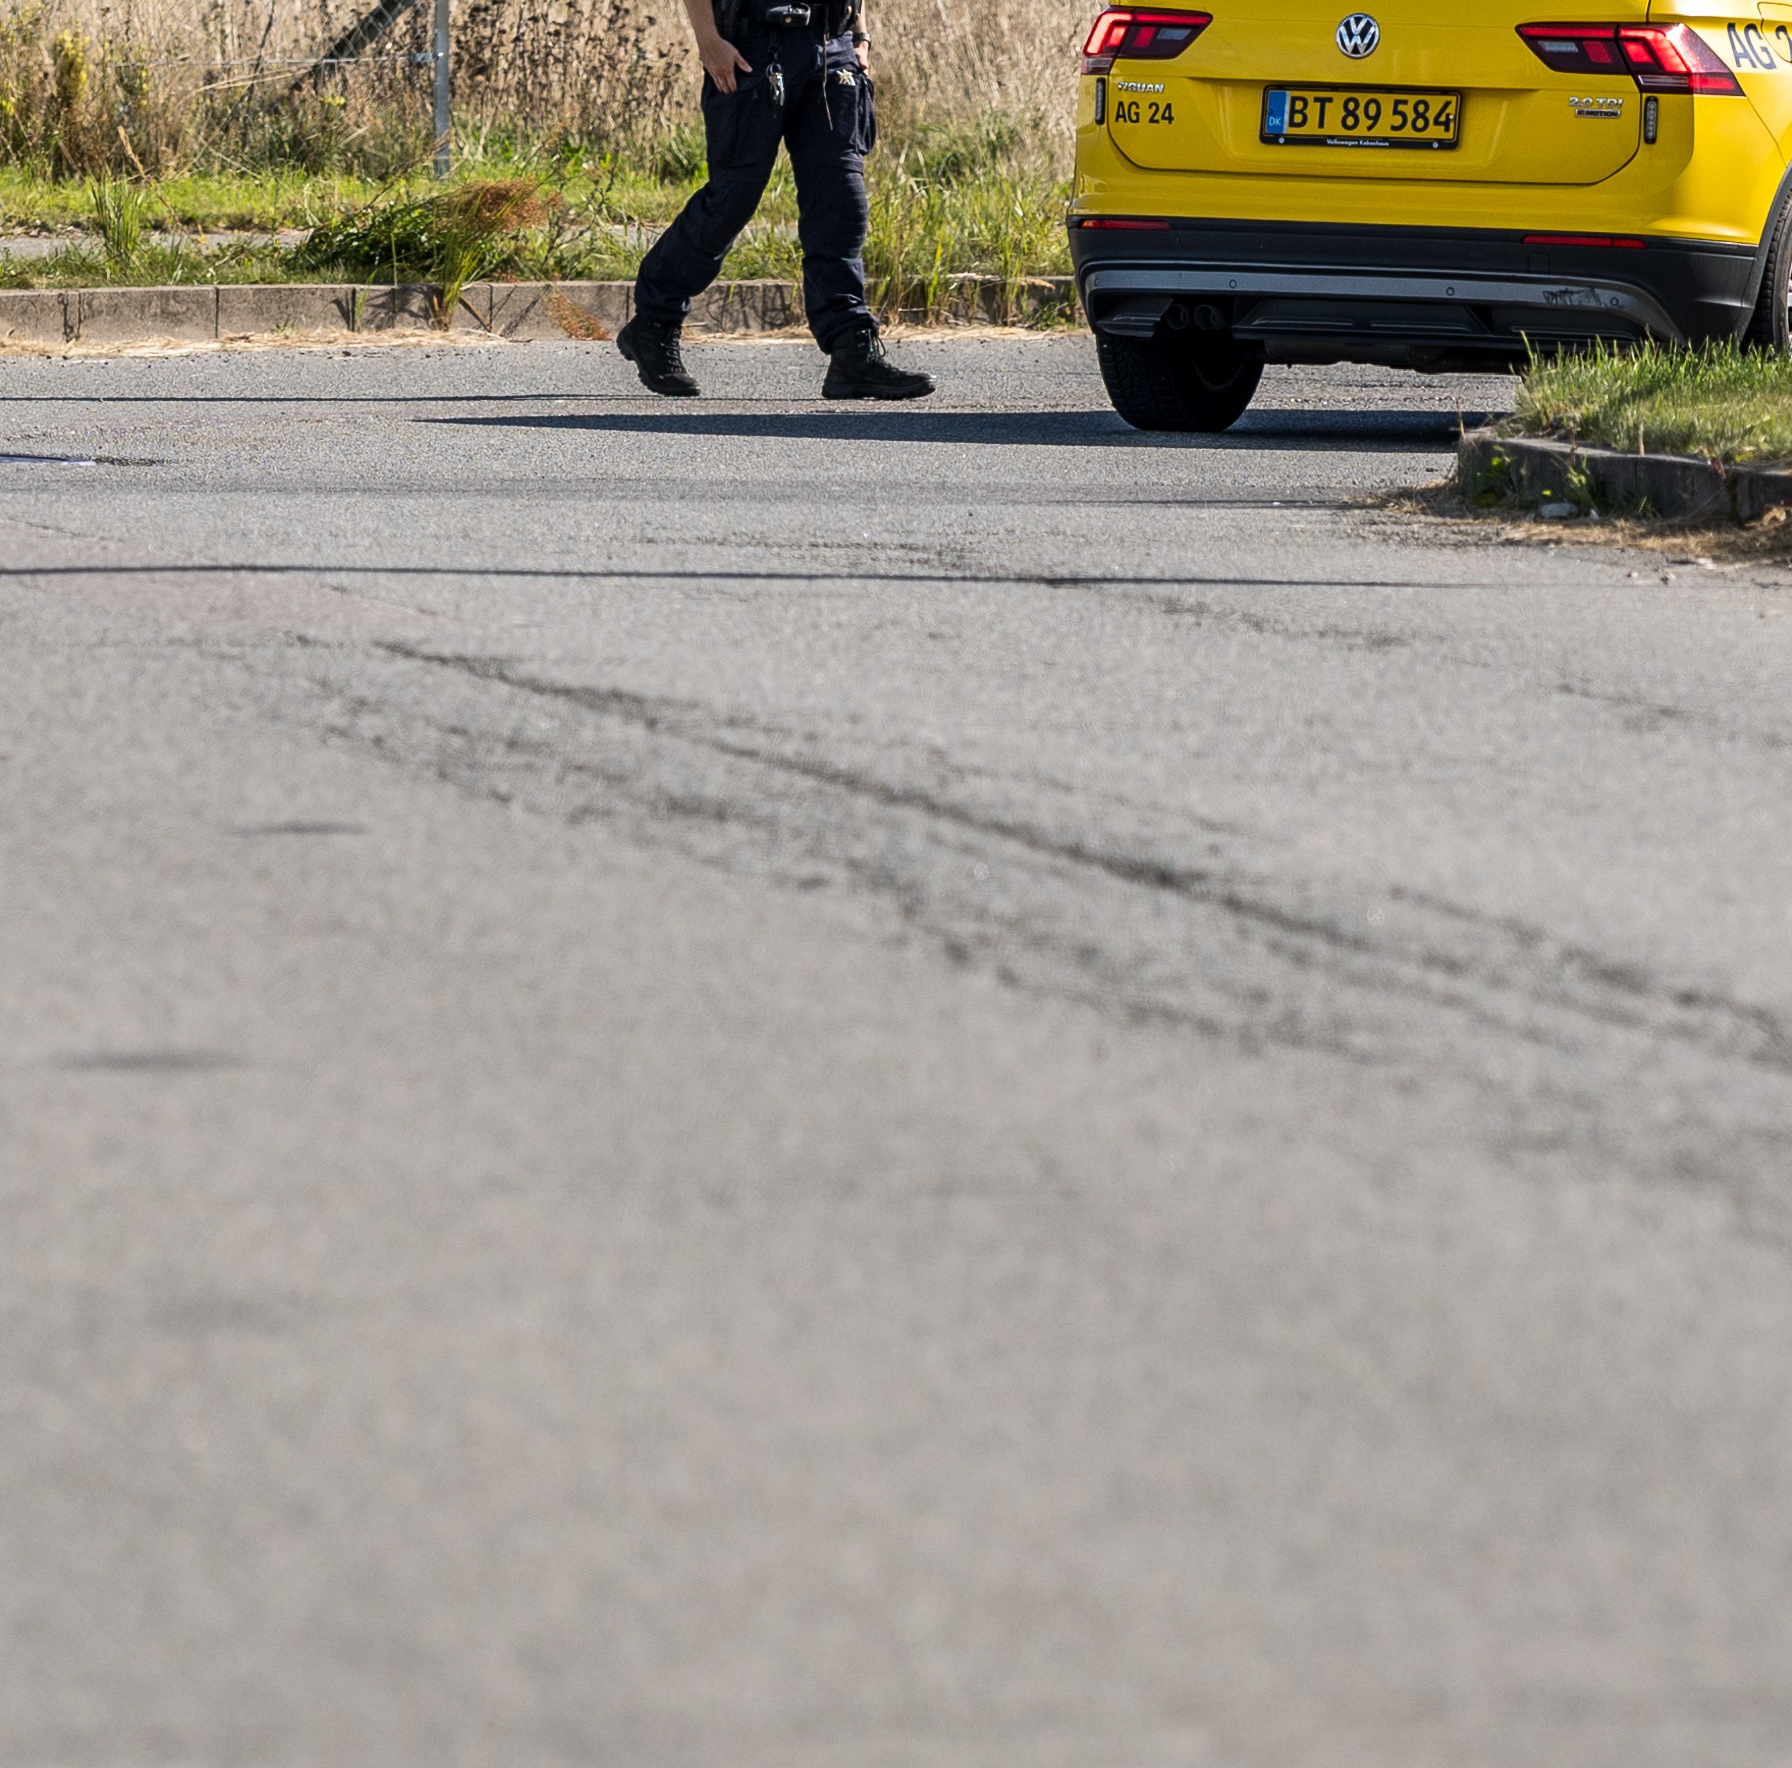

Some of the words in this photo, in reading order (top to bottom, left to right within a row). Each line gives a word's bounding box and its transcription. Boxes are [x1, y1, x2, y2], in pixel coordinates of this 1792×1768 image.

[1727, 22, 1776, 69] AG
[1117, 82, 1165, 93] TIGUAN
[1569, 96, 1593, 107] 2.0
[1595, 97, 1623, 108] TDI
[1114, 100, 1140, 123] AG
[1148, 101, 1175, 125] 24
[1268, 116, 1282, 127] DK
[1288, 96, 1334, 129] BT
[1340, 97, 1382, 132] 89
[1390, 99, 1454, 133] 584
